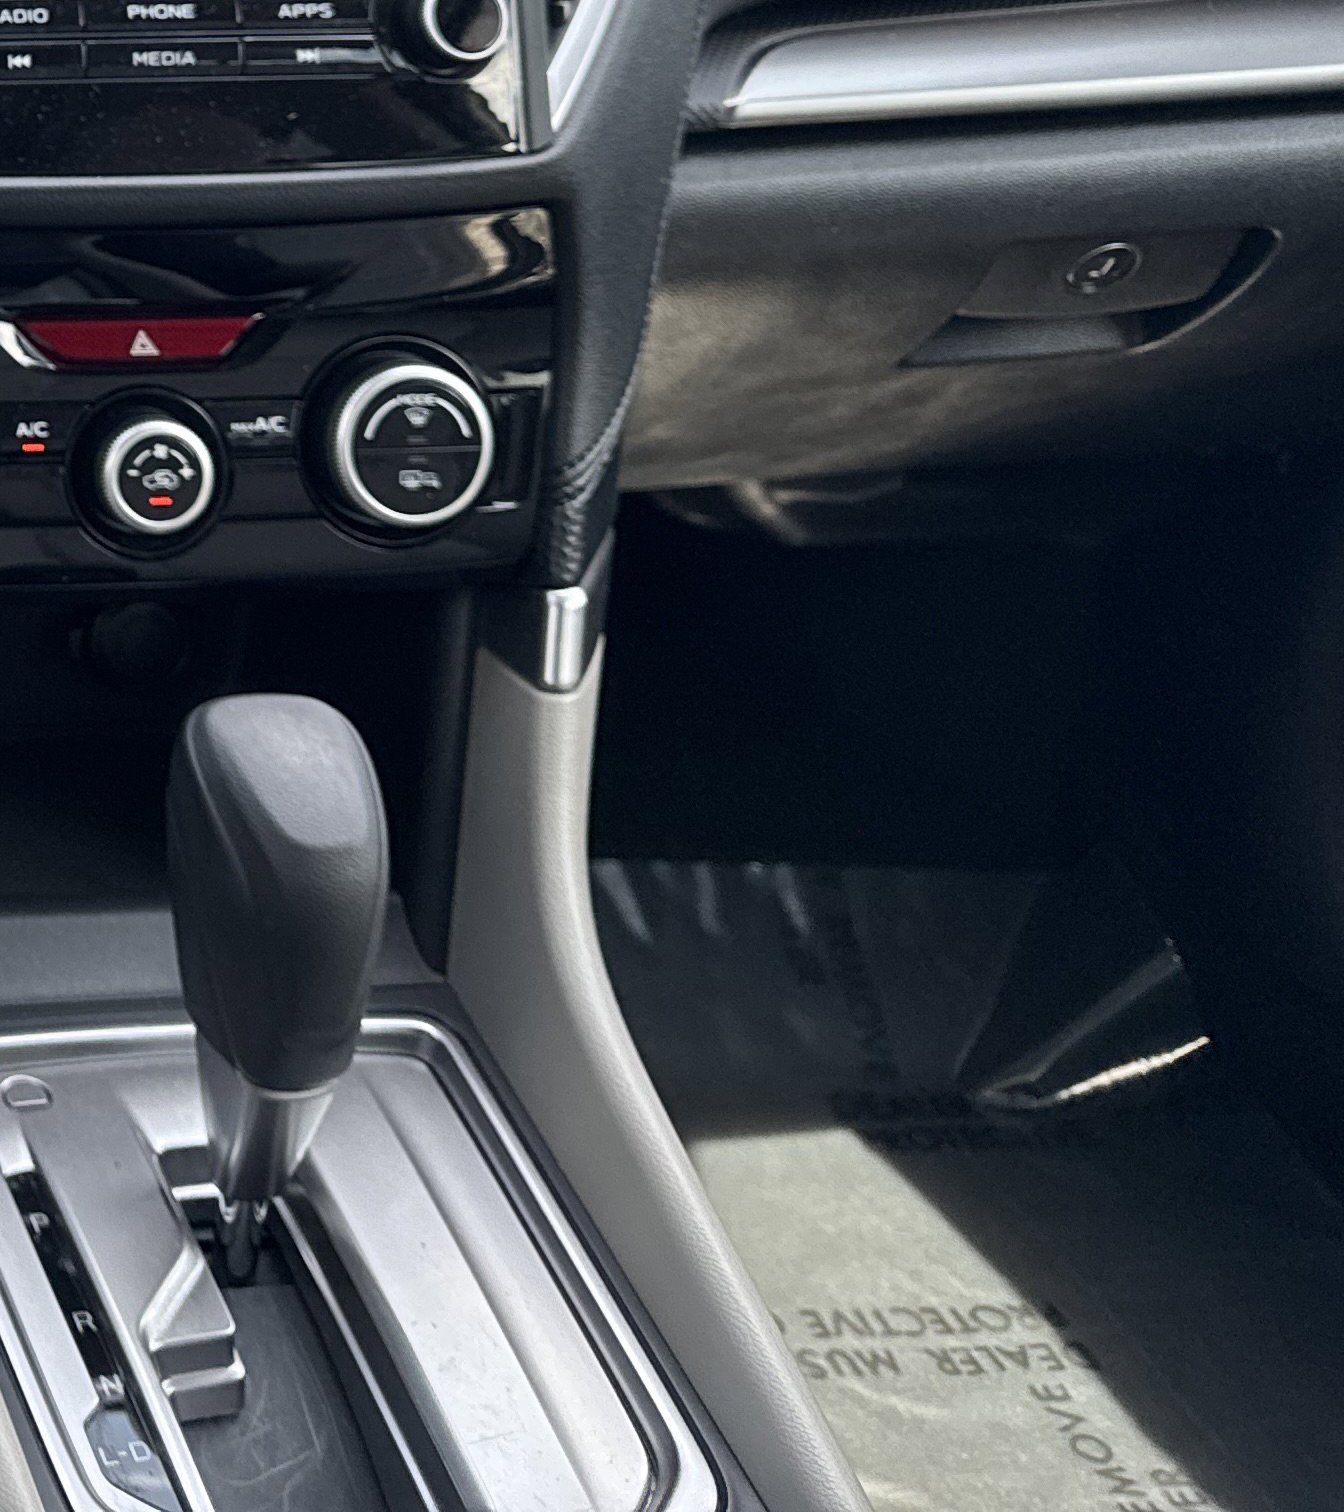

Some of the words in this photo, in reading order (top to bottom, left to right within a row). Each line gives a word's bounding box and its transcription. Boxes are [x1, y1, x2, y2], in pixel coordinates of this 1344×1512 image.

[127, 3, 198, 20] PHONE
[277, 3, 336, 19] APPS
[132, 50, 197, 67] MEDIA
[15, 421, 51, 438] A/C
[29, 1212, 50, 1238] P
[71, 1310, 99, 1335] R
[98, 1376, 125, 1397] N
